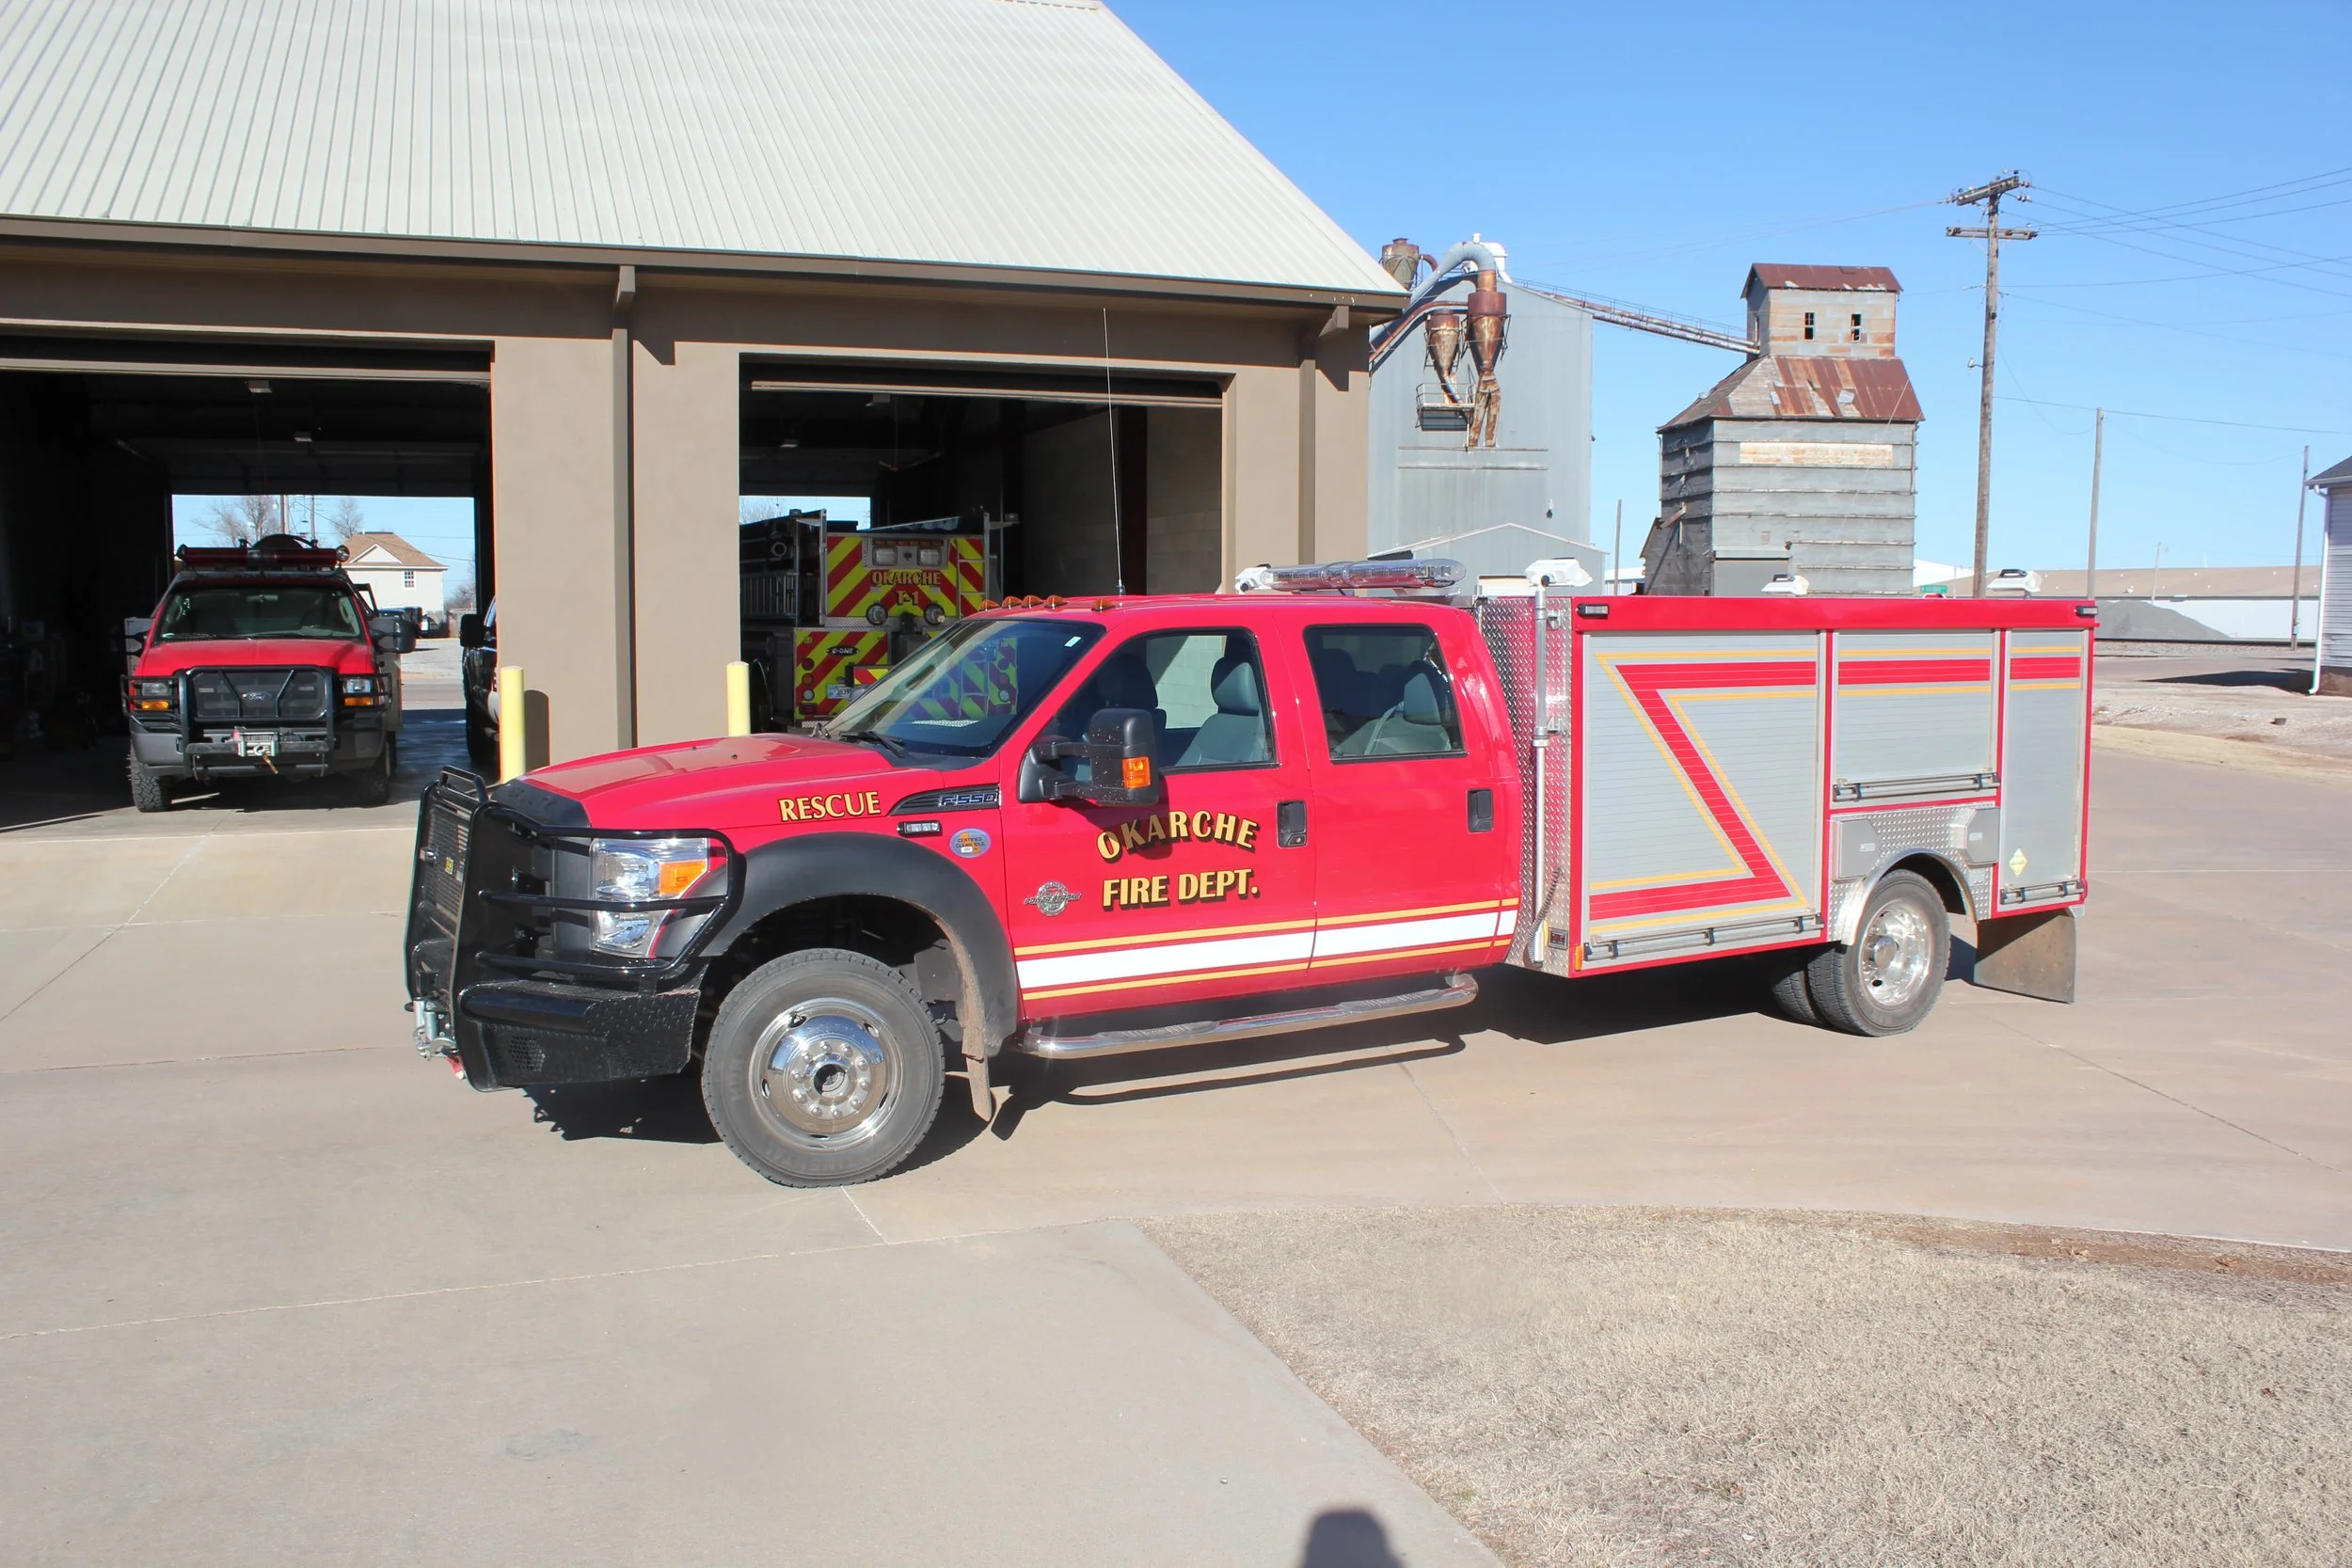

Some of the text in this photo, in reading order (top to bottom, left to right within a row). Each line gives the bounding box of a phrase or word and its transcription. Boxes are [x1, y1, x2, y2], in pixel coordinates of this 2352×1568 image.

[872, 571, 941, 585] OKARCHE
[778, 791, 882, 821] RESCUE
[1096, 810, 1259, 861] OKARCHE
[1103, 868, 1260, 909] FIRE DEPT.
